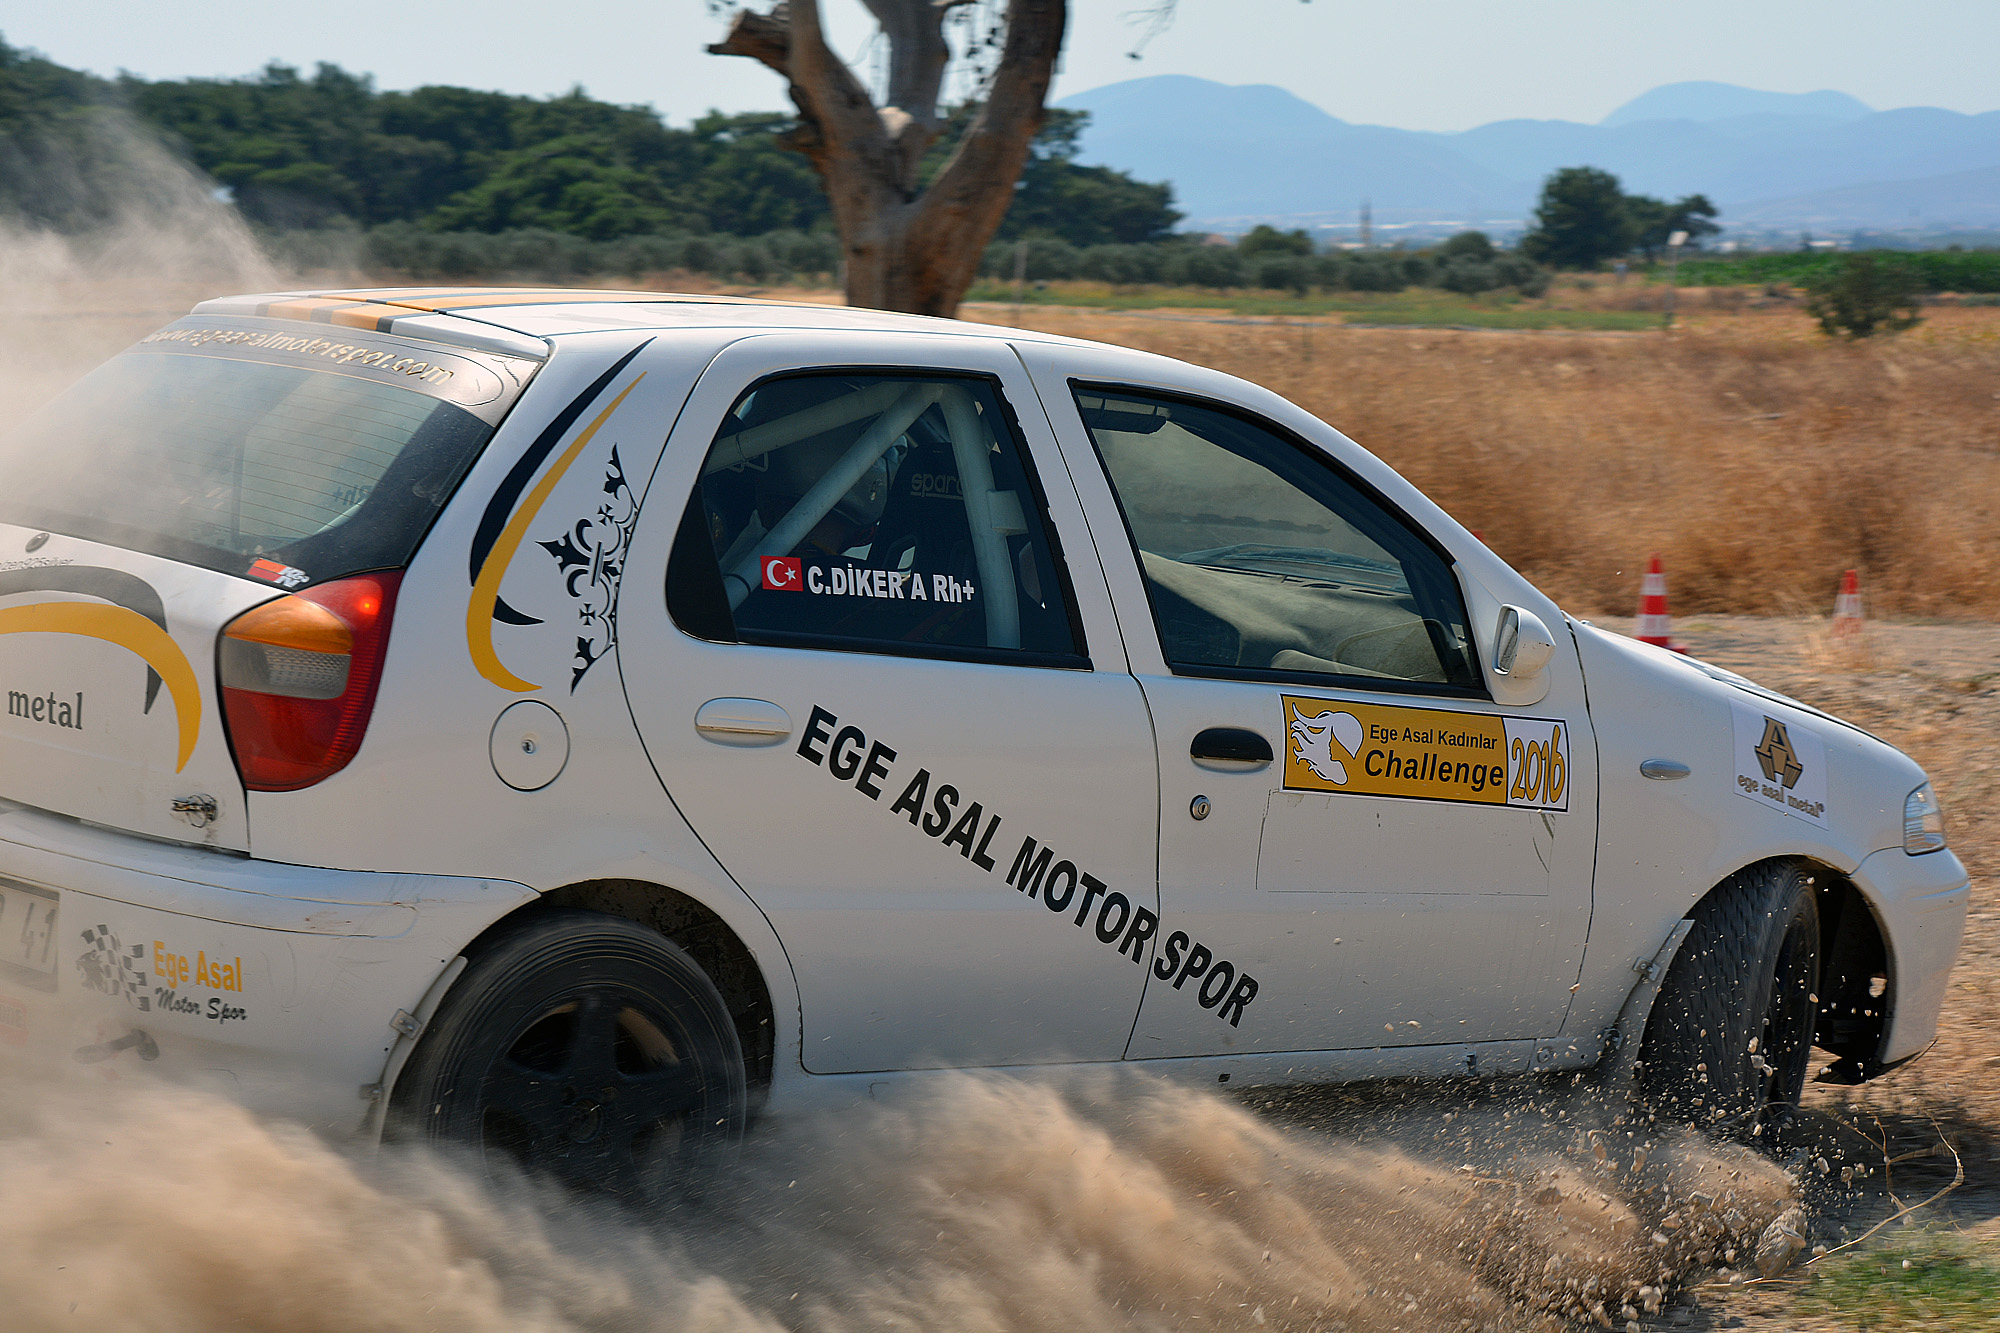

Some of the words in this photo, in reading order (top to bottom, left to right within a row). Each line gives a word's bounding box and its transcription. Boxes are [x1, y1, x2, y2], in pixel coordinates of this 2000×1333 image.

[807, 563, 904, 599] C.DİKER
[910, 572, 928, 601] A
[932, 574, 975, 603] Rh+
[8, 689, 83, 730] metal
[1370, 724, 1398, 744] Ege
[1402, 727, 1433, 744] Asal
[1438, 730, 1498, 750] Kadınlar
[1364, 749, 1504, 792] Challenge
[1510, 725, 1566, 804] 2016
[1737, 774, 1759, 793] ege
[1762, 784, 1785, 803] asal
[796, 704, 898, 801] EGE
[889, 767, 1002, 873] ASAL
[1005, 835, 1158, 965] MOTOR
[1153, 930, 1260, 1029] SPOR
[154, 940, 189, 990] Ege
[196, 950, 242, 992] Asal
[155, 987, 202, 1015] Motor
[206, 998, 248, 1024] Spor
